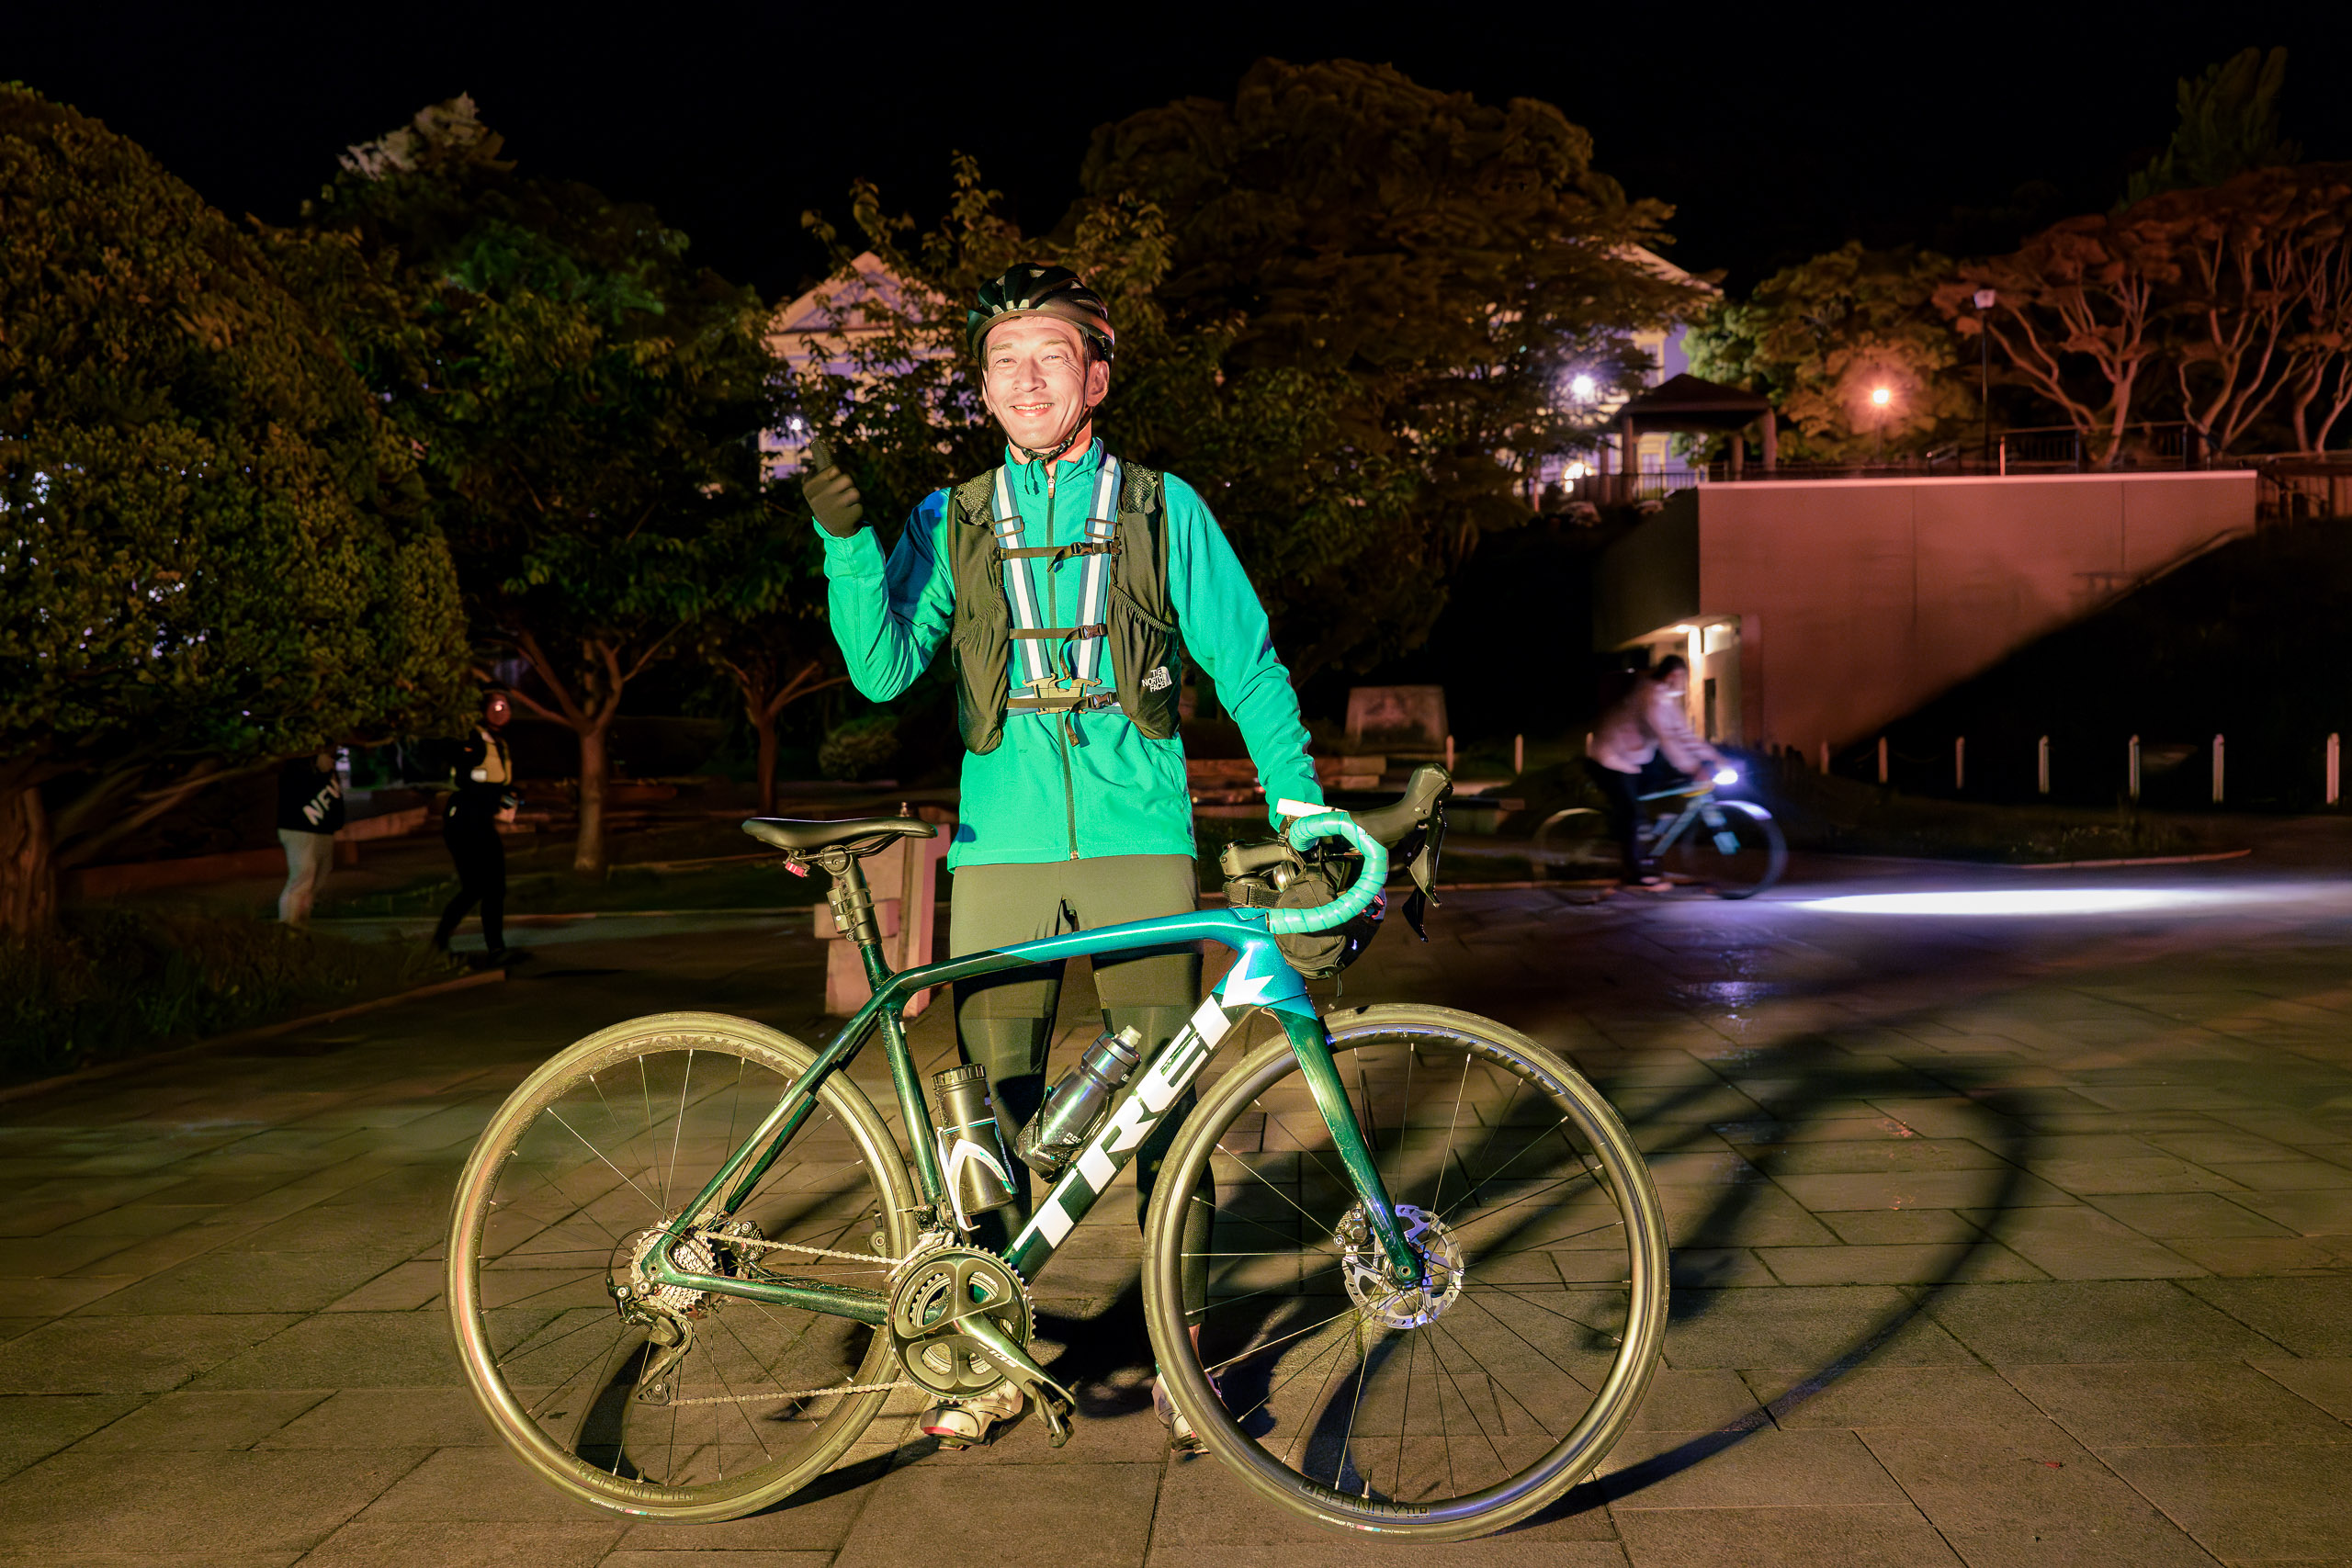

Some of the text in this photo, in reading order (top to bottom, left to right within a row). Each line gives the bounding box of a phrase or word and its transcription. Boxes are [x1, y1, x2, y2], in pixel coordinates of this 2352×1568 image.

[1141, 674, 1164, 687] NORTH
[1150, 682, 1167, 693] FACE
[1012, 942, 1275, 1253] TREK
